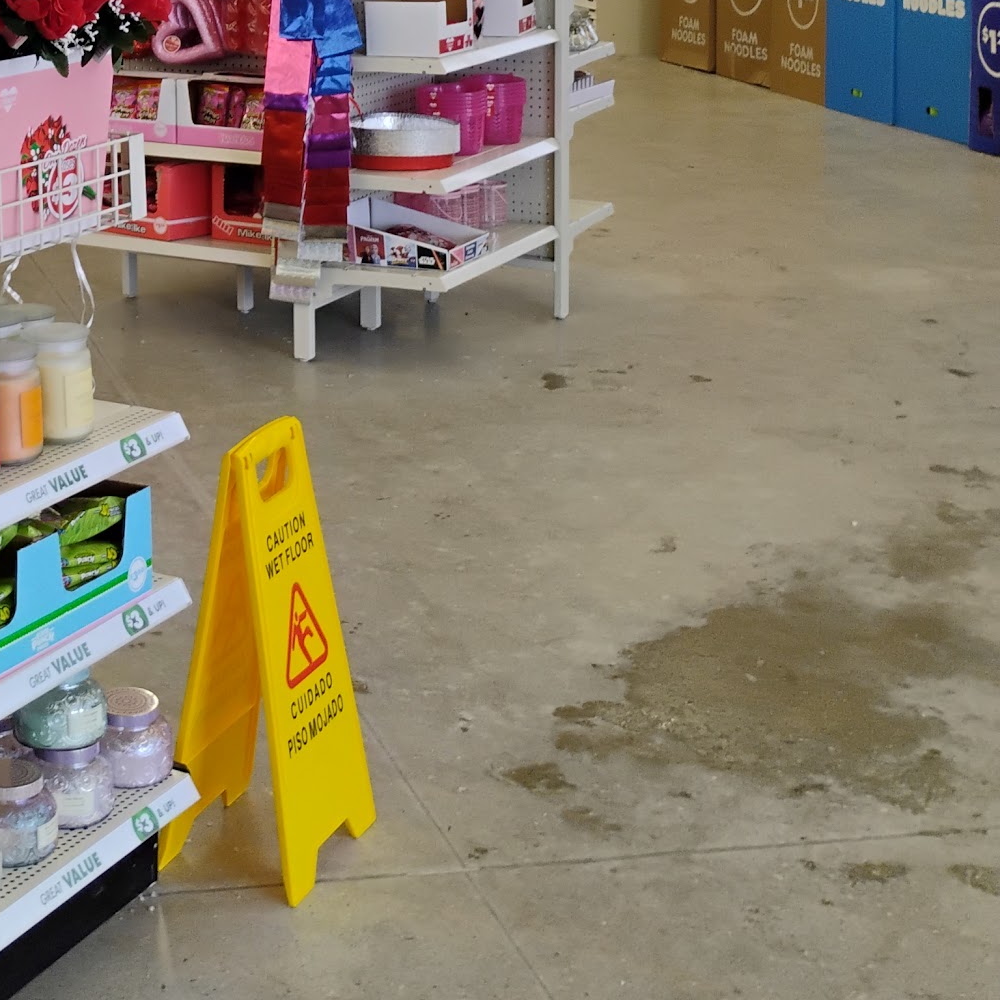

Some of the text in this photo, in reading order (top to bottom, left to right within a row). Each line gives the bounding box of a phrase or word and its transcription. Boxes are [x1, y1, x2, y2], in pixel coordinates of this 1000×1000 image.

[671, 28, 706, 46] NOODLES
[678, 15, 700, 31] FOAM
[731, 27, 758, 45] FOAM
[724, 40, 768, 61] NOODLES
[781, 55, 821, 78] NOODLES
[789, 42, 814, 60] FOAM
[237, 228, 261, 239] Mike
[25, 487, 49, 503] GREAT
[49, 464, 89, 493] VALUE
[145, 436, 152, 446] &
[152, 431, 164, 444] UP!
[266, 511, 306, 552] CAUTION
[265, 532, 314, 580] WET FLOOR
[28, 670, 52, 689] GREAT
[51, 642, 92, 675] VALUE
[147, 605, 154, 617] &
[154, 600, 166, 613] UP!
[290, 671, 333, 720] CUIDADO
[287, 693, 344, 759] PISO MOJADO
[39, 880, 63, 906] GREAT
[61, 852, 102, 888] VALUE
[164, 798, 176, 813] UP!
